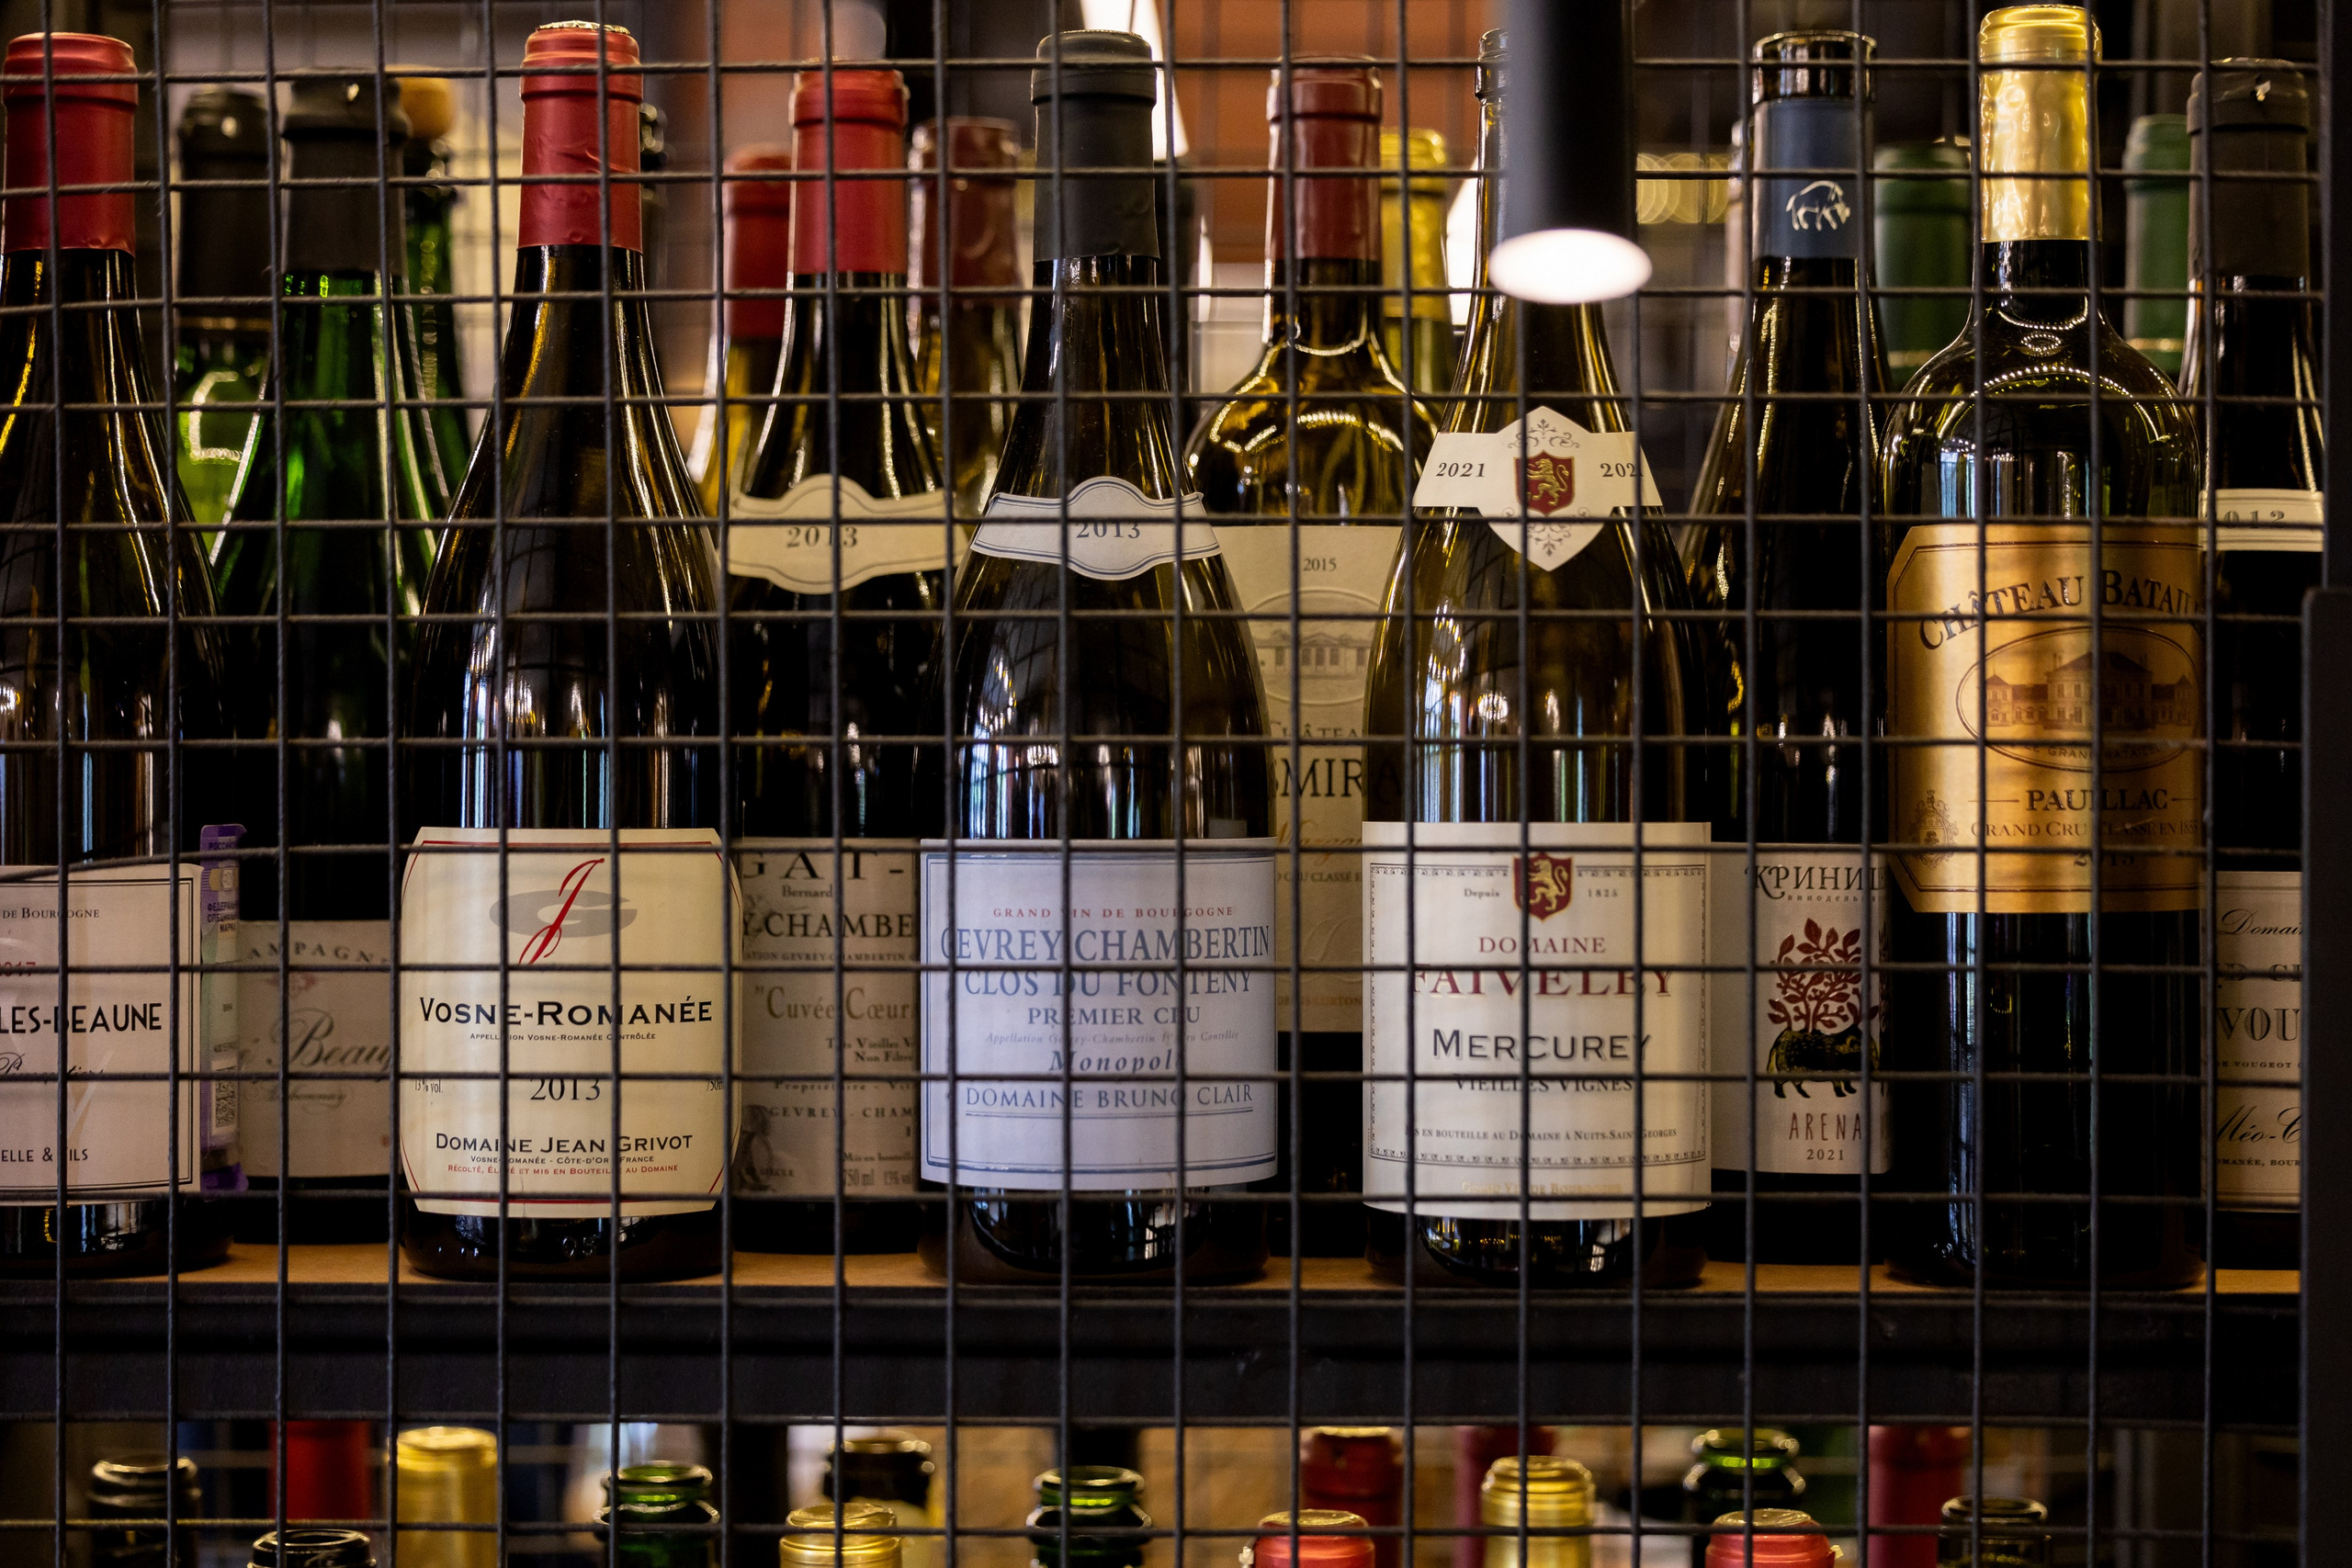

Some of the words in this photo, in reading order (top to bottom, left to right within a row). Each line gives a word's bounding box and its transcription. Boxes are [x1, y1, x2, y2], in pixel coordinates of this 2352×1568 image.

[1435, 462, 1486, 478] 2021
[1600, 462, 1644, 479] 202
[786, 525, 858, 547] 2013
[1076, 520, 1141, 539] 2013
[1303, 558, 1337, 571] 2015
[2046, 821, 2086, 837] CRU
[1464, 887, 1500, 898] Depuis
[1588, 887, 1618, 898] 1825
[3, 910, 17, 919] DE
[22, 908, 100, 919] BOUROGNE
[993, 908, 1051, 918] GRAND
[1102, 908, 1124, 918] DE
[1075, 925, 1270, 961] CHAMBERTIN
[530, 1078, 600, 1100] 2013
[1197, 1084, 1253, 1105] CLAIR
[1789, 1112, 1861, 1141] ARENA
[42, 1147, 53, 1162] &
[65, 1147, 88, 1161] ILS
[470, 1156, 546, 1164] VOSNE-OMANÉE
[1806, 1148, 1845, 1160] 2021
